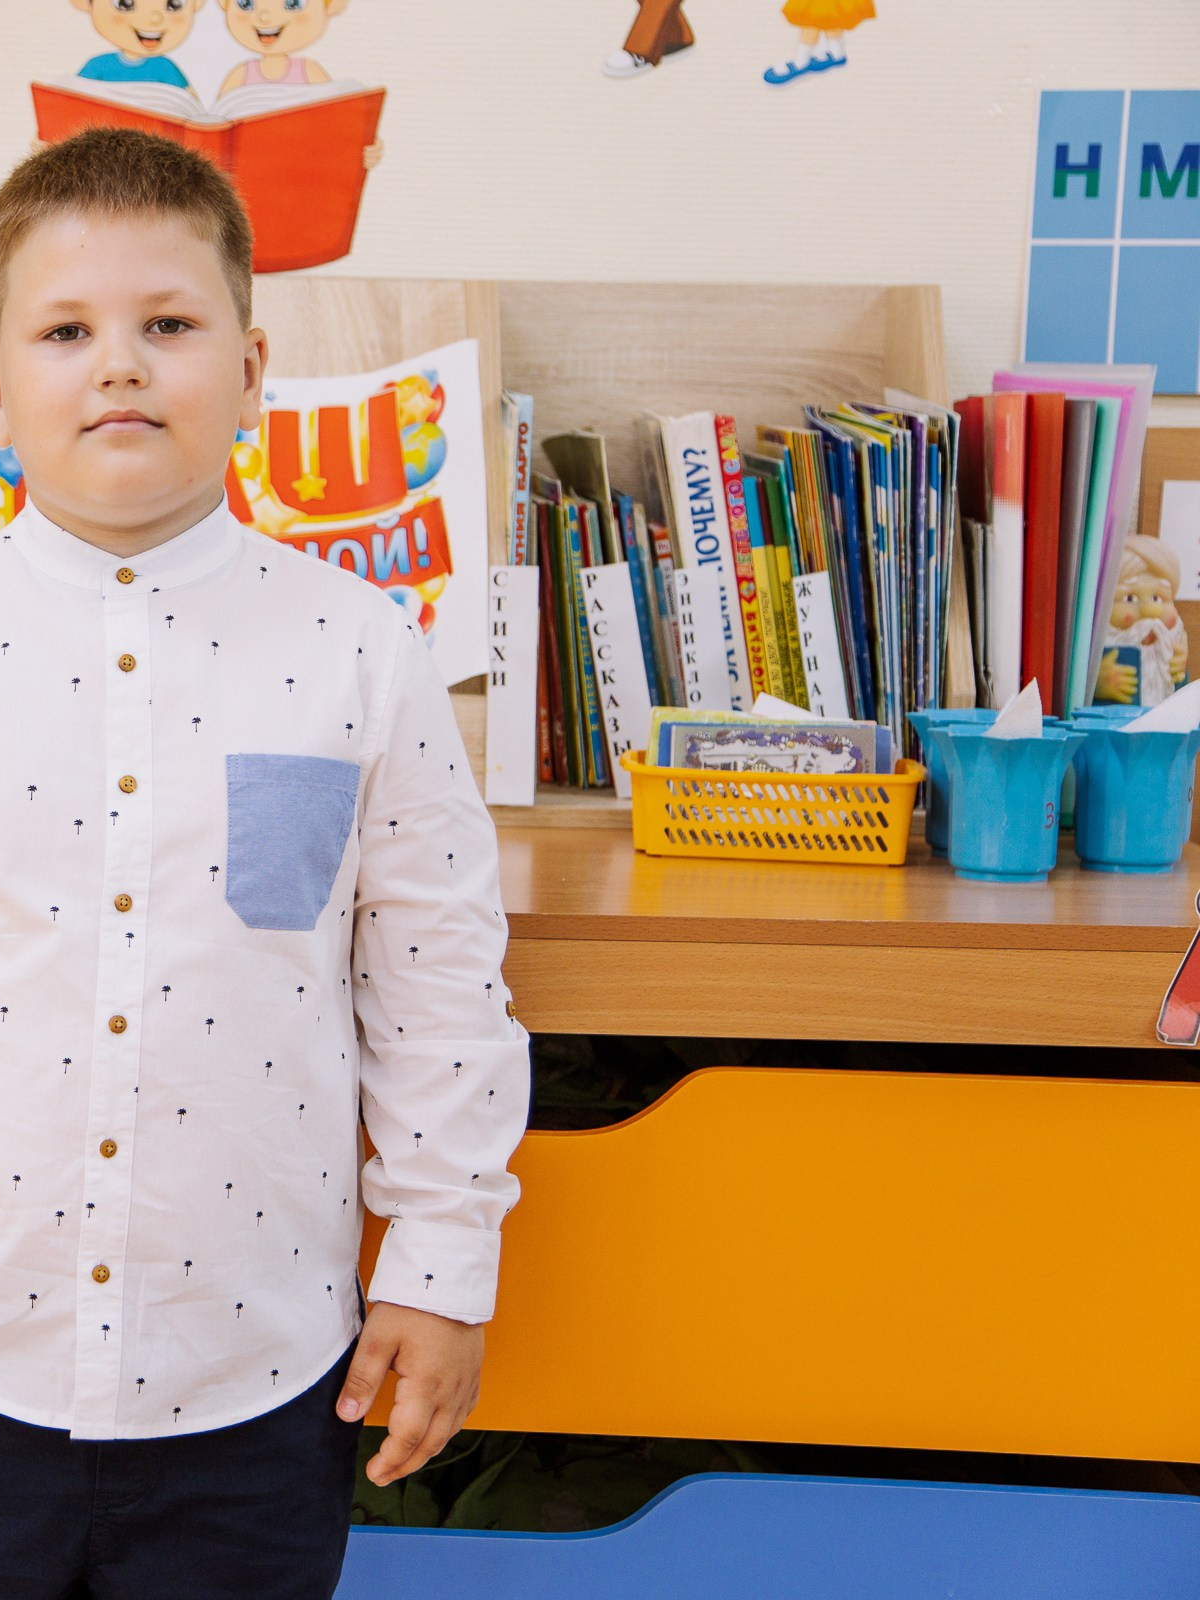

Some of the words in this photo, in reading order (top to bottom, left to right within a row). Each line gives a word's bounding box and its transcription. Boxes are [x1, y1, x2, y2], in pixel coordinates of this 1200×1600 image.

[1052, 143, 1102, 199] Н
[1139, 143, 1200, 199] М
[224, 391, 408, 522] Ш
[516, 422, 529, 492] БАРТО
[514, 503, 526, 567] АГНИЯ
[728, 480, 754, 578] ДЕТСКОГО
[492, 571, 508, 687] СТИХИ
[585, 573, 633, 756] РАССКАЗЫ
